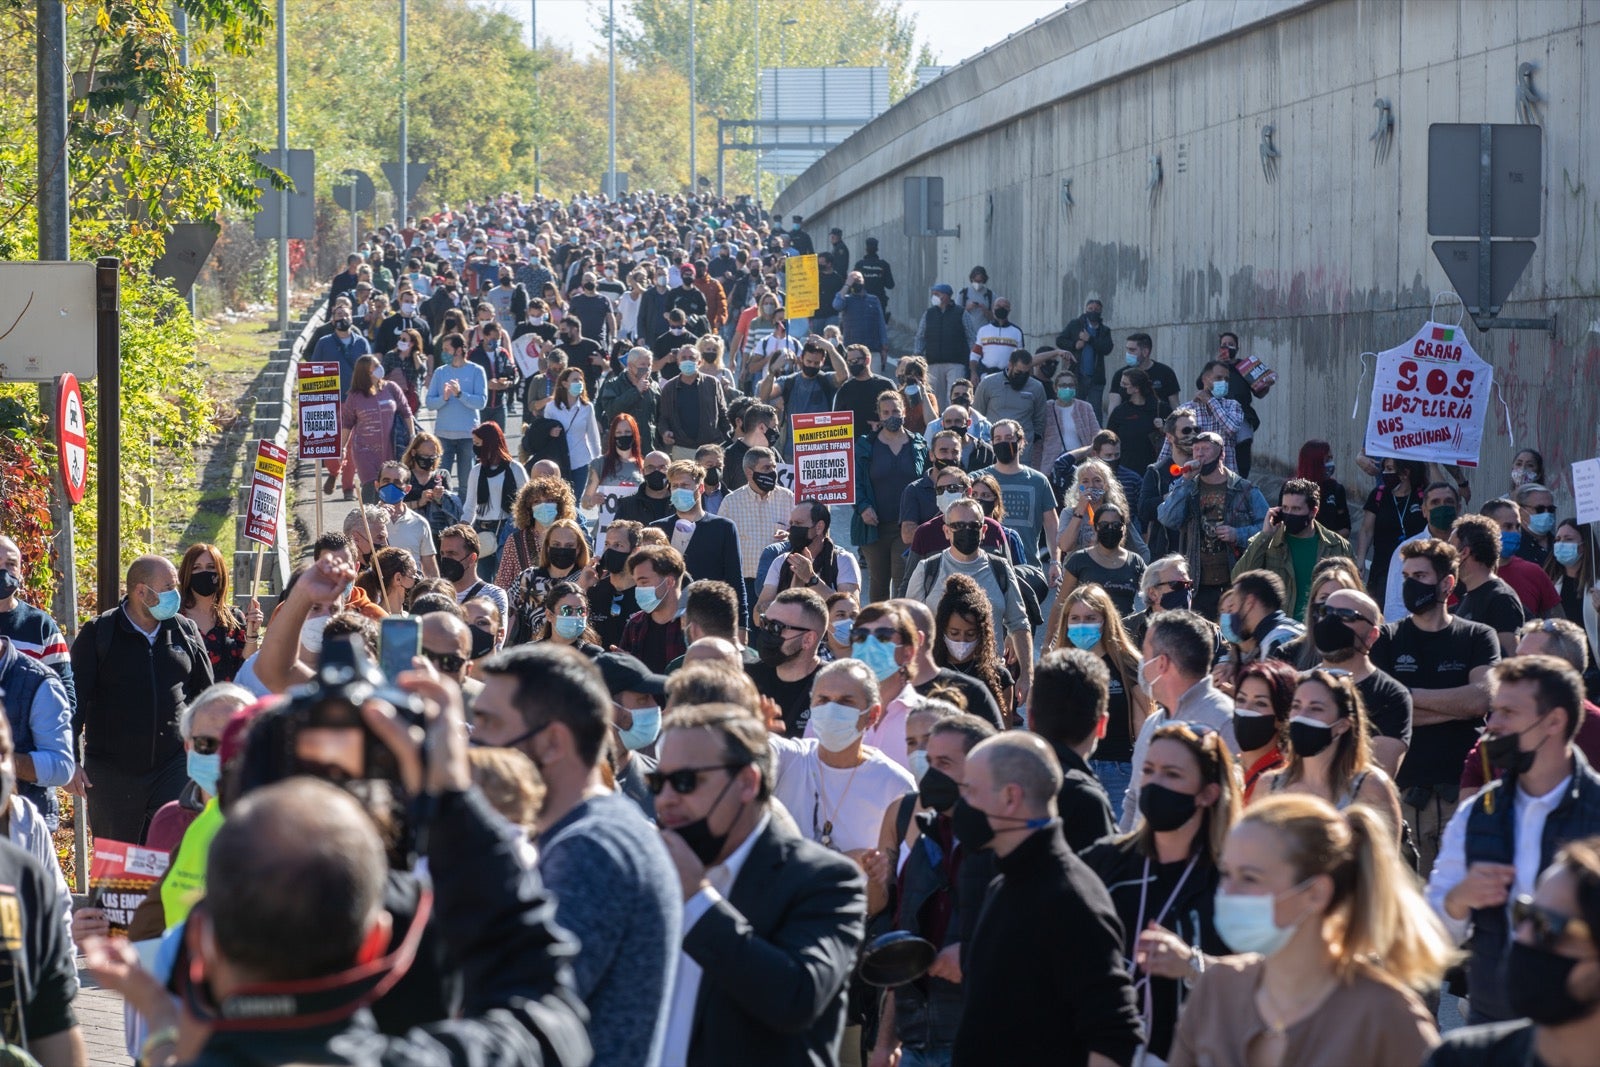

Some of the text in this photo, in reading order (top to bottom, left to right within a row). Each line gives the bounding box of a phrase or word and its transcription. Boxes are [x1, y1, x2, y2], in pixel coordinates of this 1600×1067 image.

[1414, 339, 1462, 361] GRANA
[302, 377, 337, 391] MANIFESTACIÓN
[305, 411, 335, 420] ¡QUEREMOS
[304, 420, 336, 431] TRABAJAR!
[1377, 416, 1404, 436] NOS
[799, 426, 849, 442] MANIFESTACIÓN
[303, 446, 336, 455] LAS GABIAS
[796, 443, 828, 452] RESTAURANTE
[803, 458, 845, 470] ¡QUEREMOS
[802, 468, 847, 480] TRABAJAR!
[817, 492, 847, 501] GABIAS
[249, 525, 260, 535] LAS
[102, 892, 119, 909] LAS
